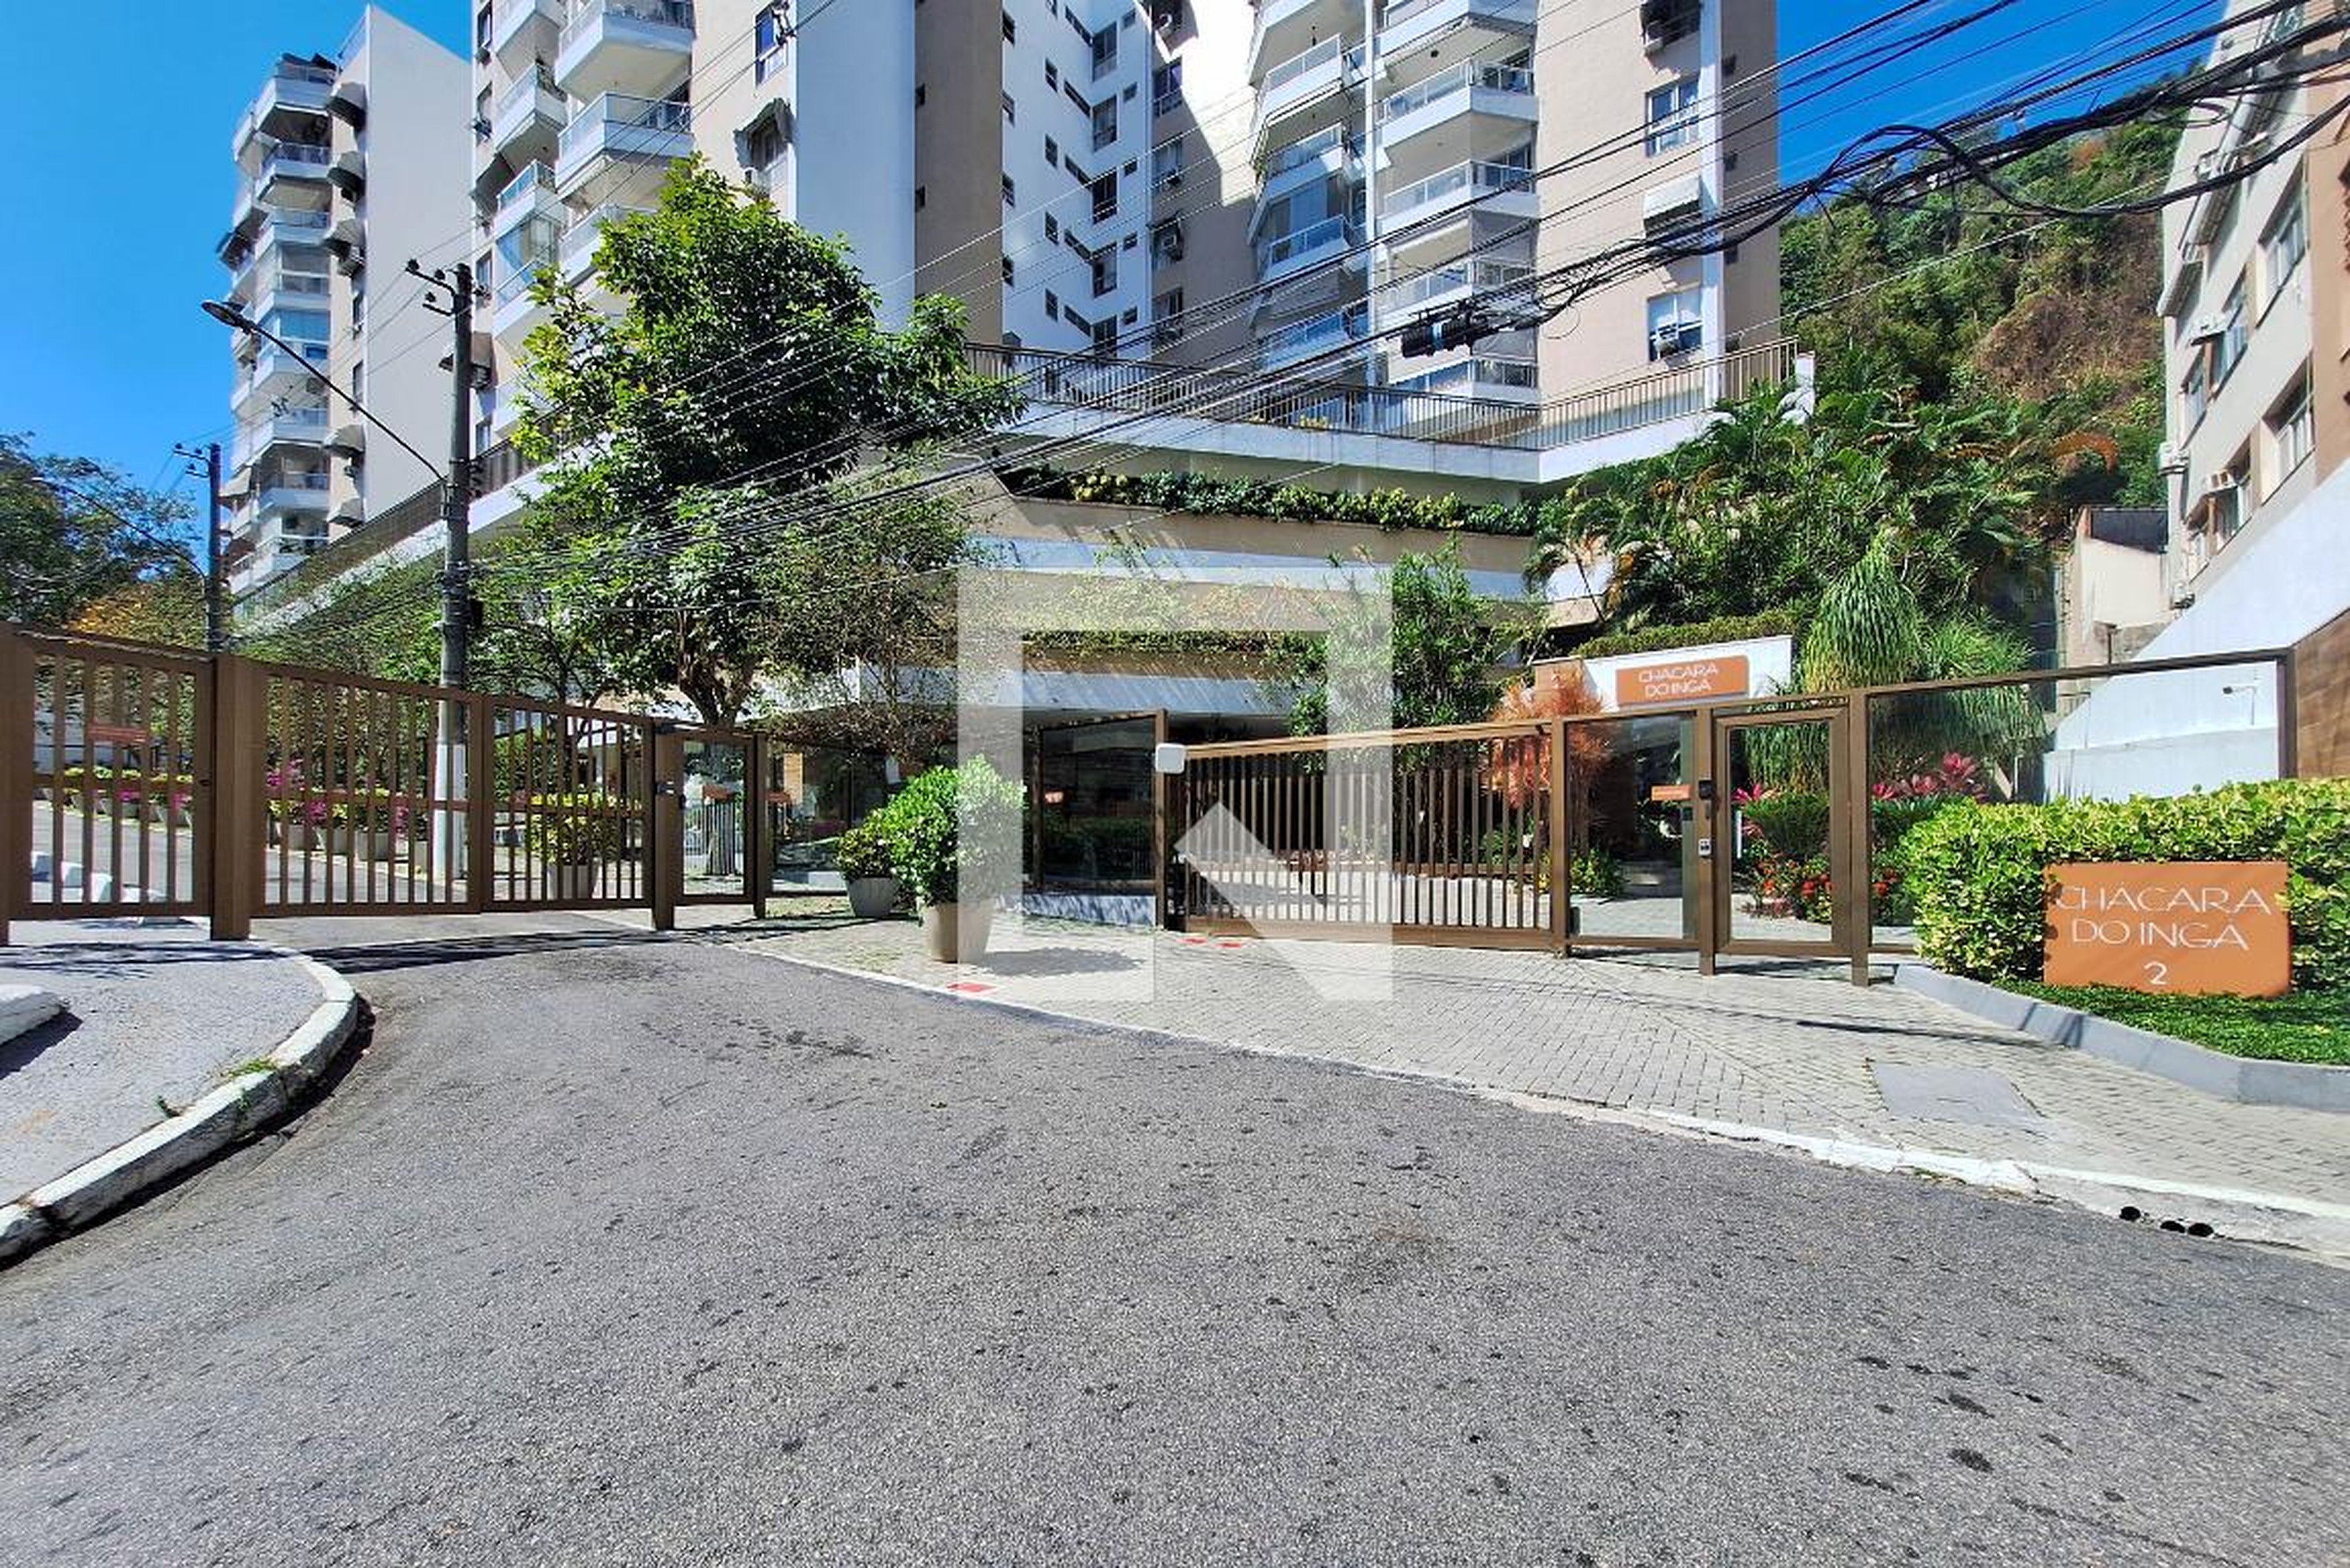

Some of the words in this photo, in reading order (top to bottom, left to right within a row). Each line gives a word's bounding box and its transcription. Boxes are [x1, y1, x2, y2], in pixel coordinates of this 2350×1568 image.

[1645, 682, 1669, 698] DO
[2072, 918, 2130, 945] DO
[2144, 960, 2168, 985] 2
